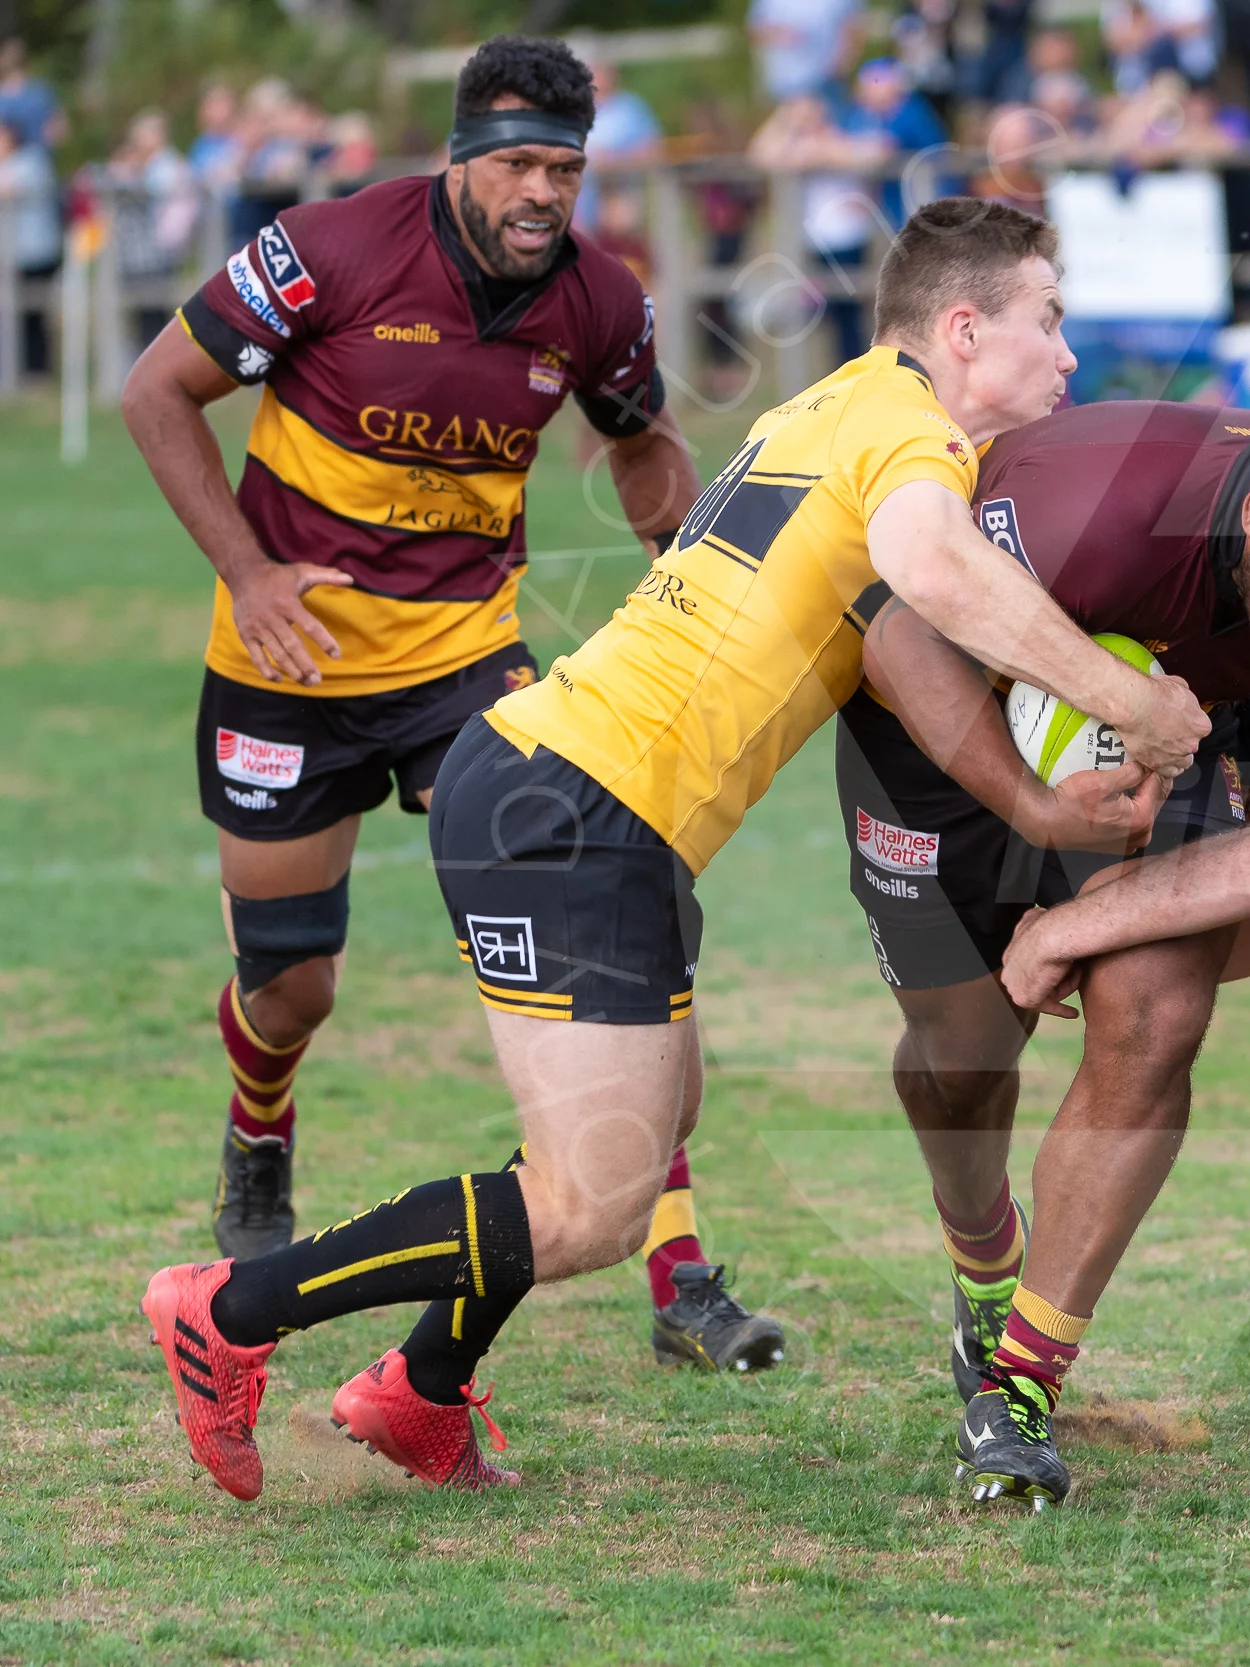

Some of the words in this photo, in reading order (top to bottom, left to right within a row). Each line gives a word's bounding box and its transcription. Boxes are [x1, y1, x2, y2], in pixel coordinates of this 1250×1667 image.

[384, 504, 504, 533] JAGUAR
[552, 665, 573, 694] UMA
[241, 737, 302, 765] Haines
[241, 753, 292, 778] Watts
[874, 819, 937, 852] Haines
[874, 837, 929, 867] Watts
